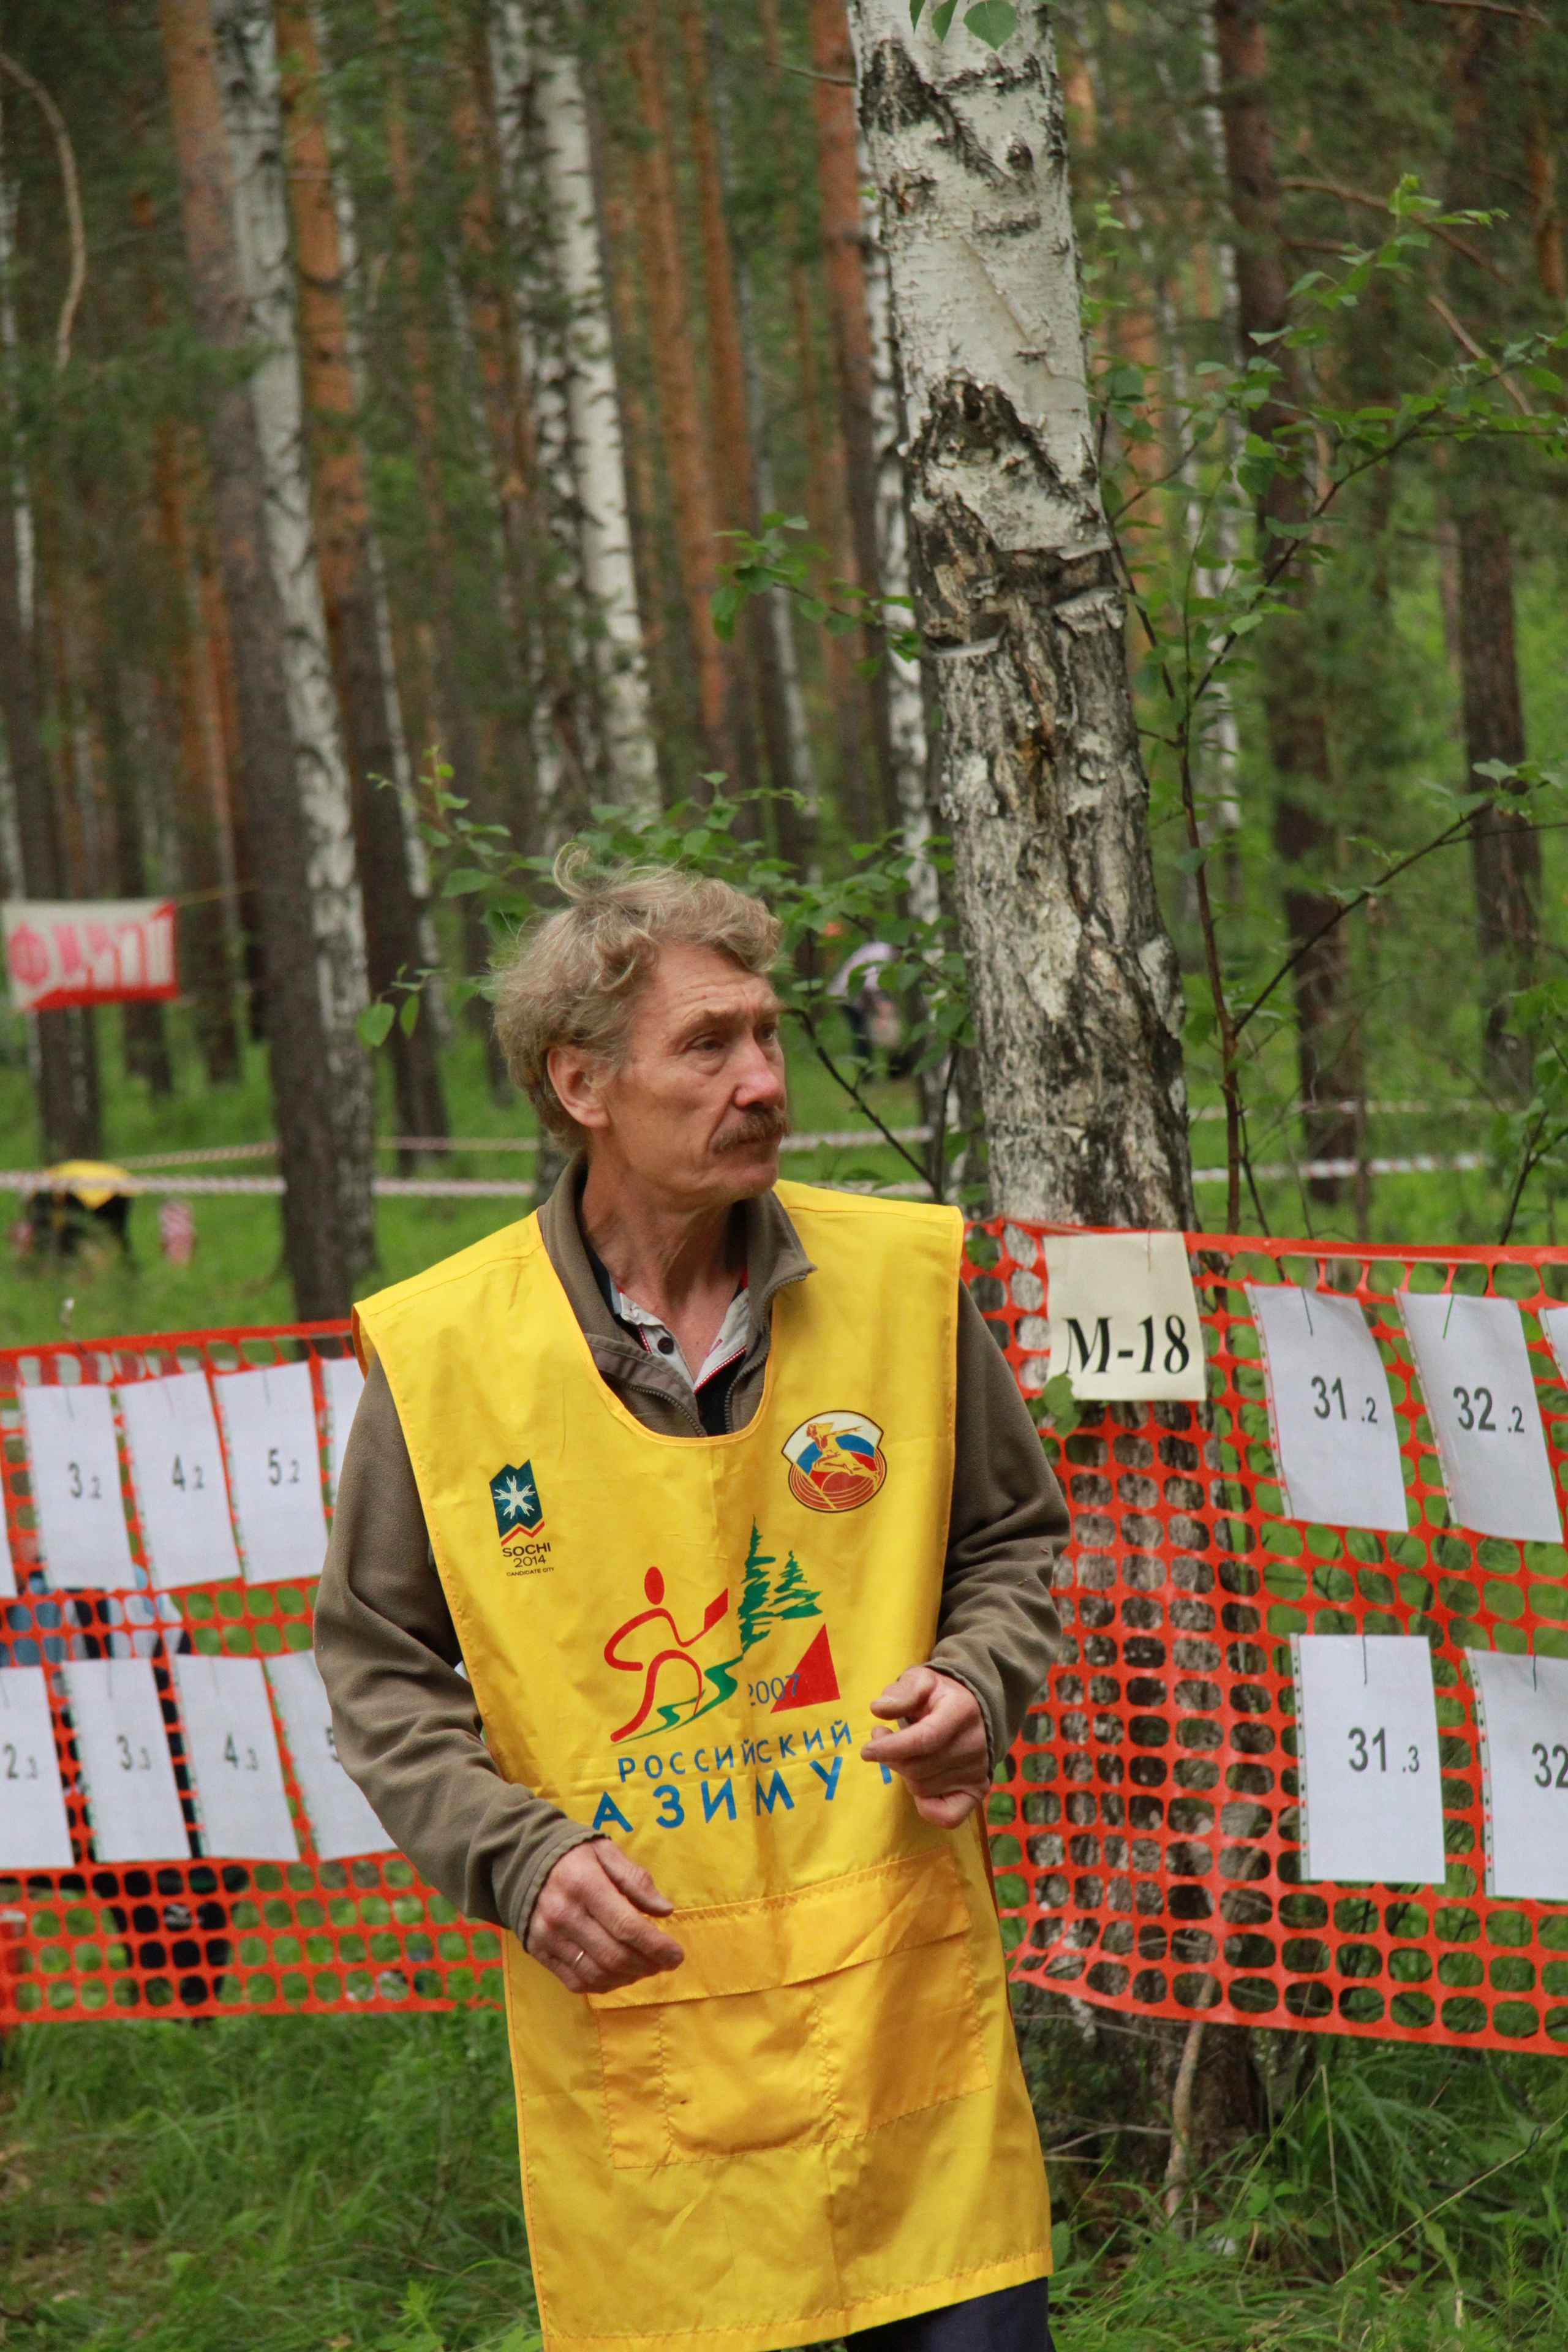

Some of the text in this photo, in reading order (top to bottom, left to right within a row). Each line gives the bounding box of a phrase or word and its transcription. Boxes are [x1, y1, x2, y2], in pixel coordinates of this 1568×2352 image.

[502, 1542, 551, 1557] SOCHI
[513, 1555, 546, 1567] 2014
[507, 1568, 541, 1577] CANDIDATE
[617, 1719, 853, 1782] РОССИЙСКИЙ
